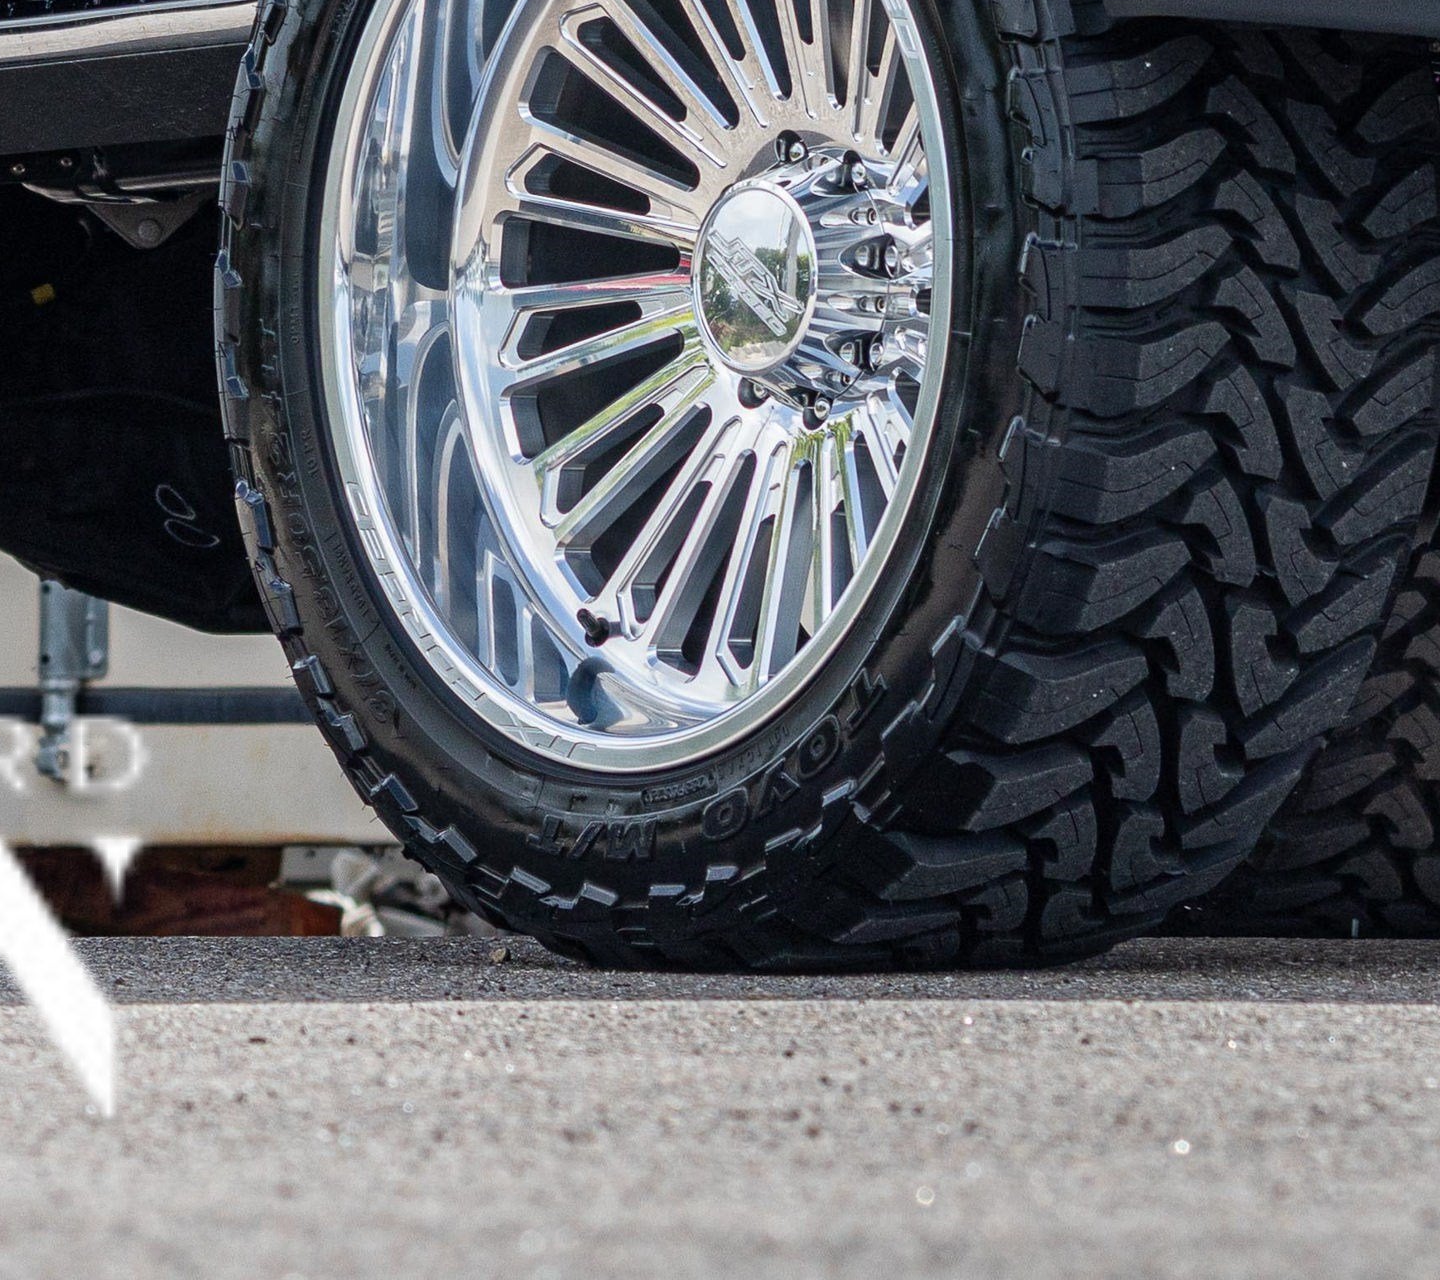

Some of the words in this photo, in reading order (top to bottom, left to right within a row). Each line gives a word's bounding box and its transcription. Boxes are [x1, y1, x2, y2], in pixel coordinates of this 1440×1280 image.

[706, 229, 805, 323] JTX
[345, 480, 487, 708] FORGED
[479, 698, 597, 762] JTX
[701, 665, 888, 842] TOYO
[526, 814, 658, 861] M/T
